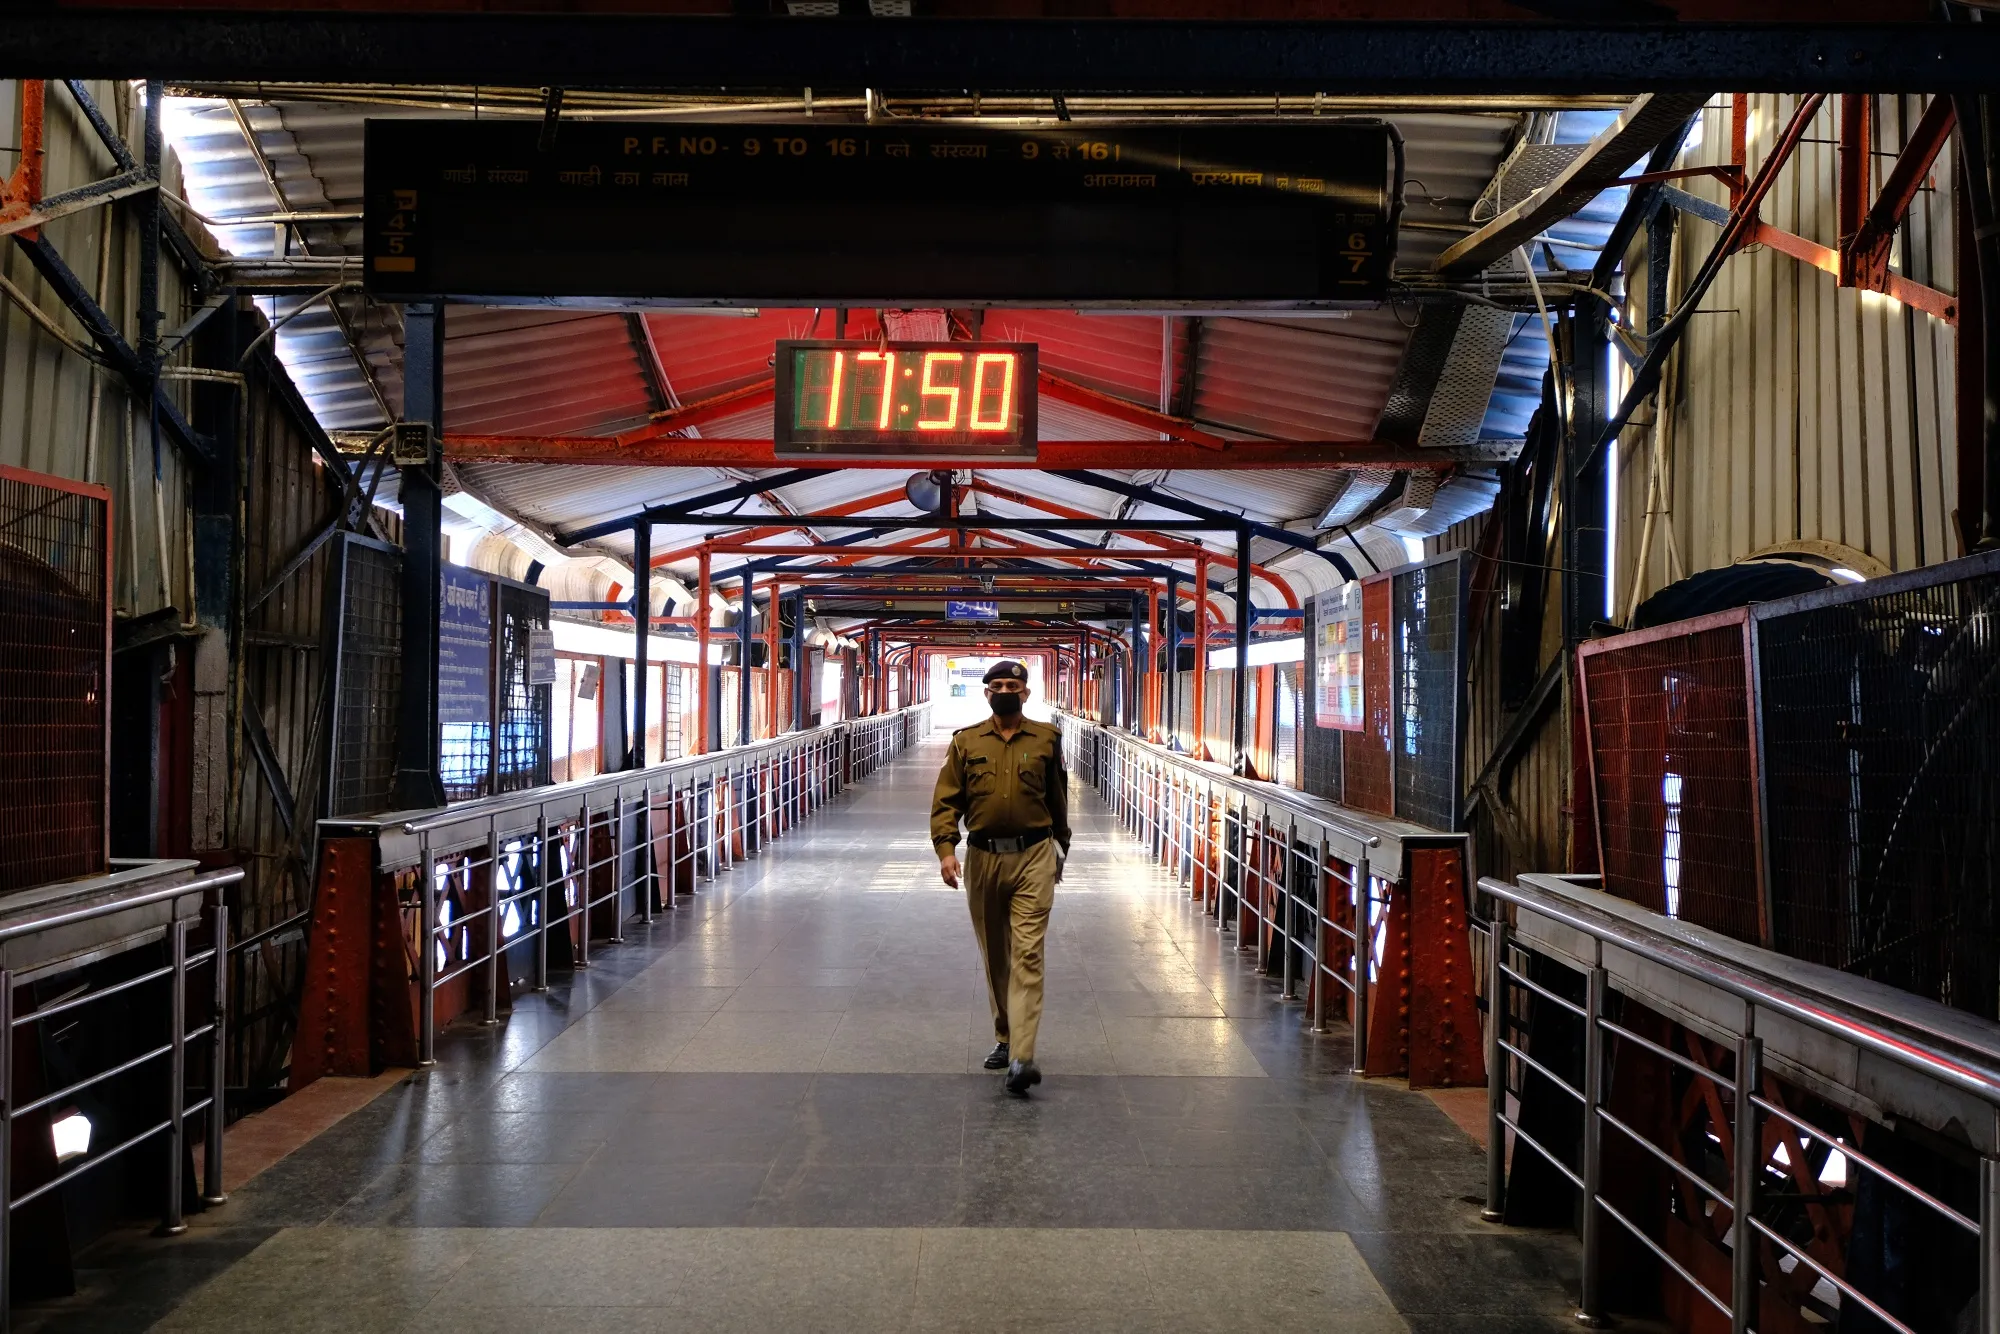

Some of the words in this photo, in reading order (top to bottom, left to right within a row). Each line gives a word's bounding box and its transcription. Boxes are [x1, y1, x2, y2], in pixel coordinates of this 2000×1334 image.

[743, 137, 760, 156] 9
[772, 137, 807, 156] TO
[929, 140, 988, 159] संख्या
[1020, 141, 1039, 160] 9
[613, 171, 640, 187] का
[652, 171, 690, 187] नाम
[1083, 173, 1157, 188] आगमन
[1191, 171, 1264, 188] प्रस्थान
[388, 211, 406, 231] 4
[388, 236, 405, 255] 5
[1347, 232, 1368, 251] 6
[1347, 256, 1366, 275] 7
[827, 351, 1015, 430] 17:50
